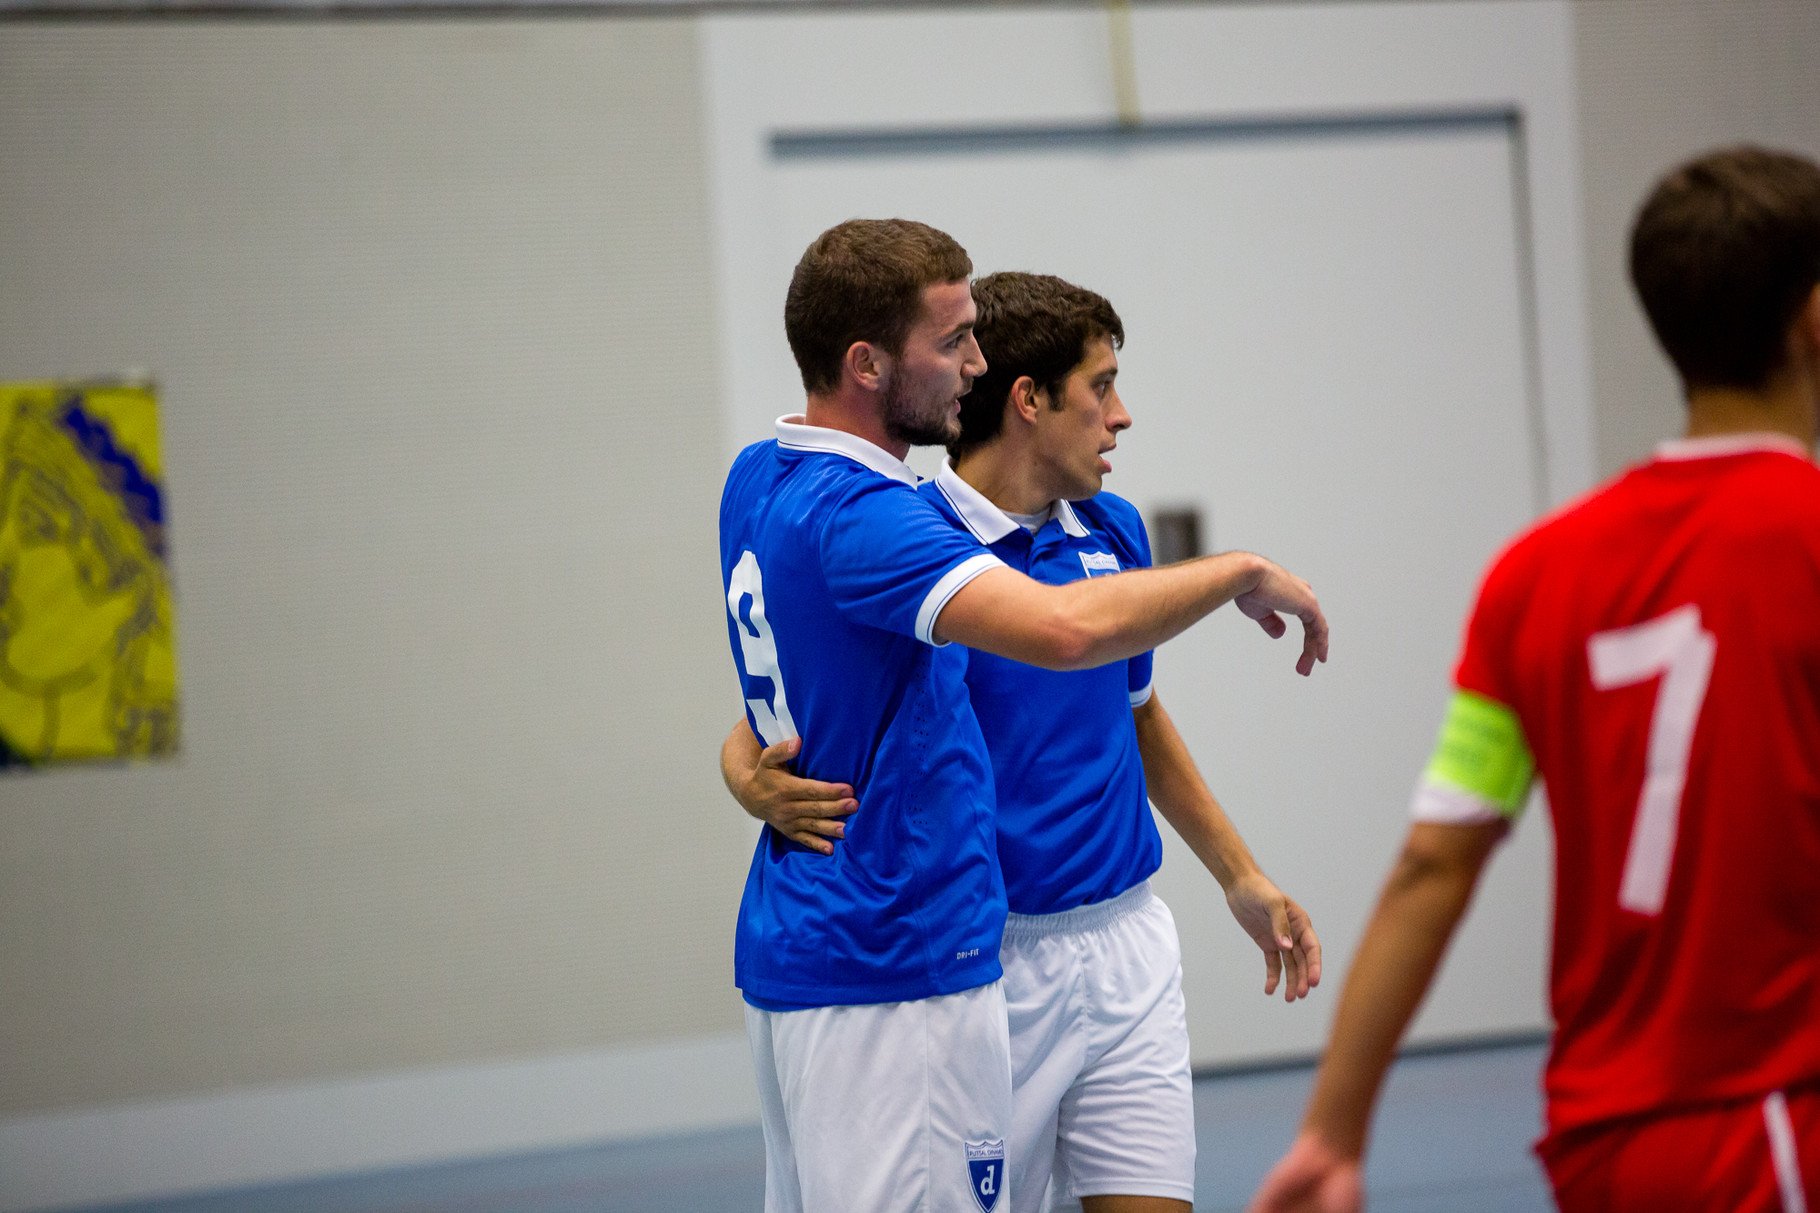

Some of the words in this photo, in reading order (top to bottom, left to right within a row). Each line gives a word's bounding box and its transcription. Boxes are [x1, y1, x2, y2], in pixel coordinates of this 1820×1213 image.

[727, 549, 800, 748] 9
[1586, 602, 1718, 917] 7
[956, 948, 979, 960] DRI-FIT
[980, 1164, 996, 1196] d
